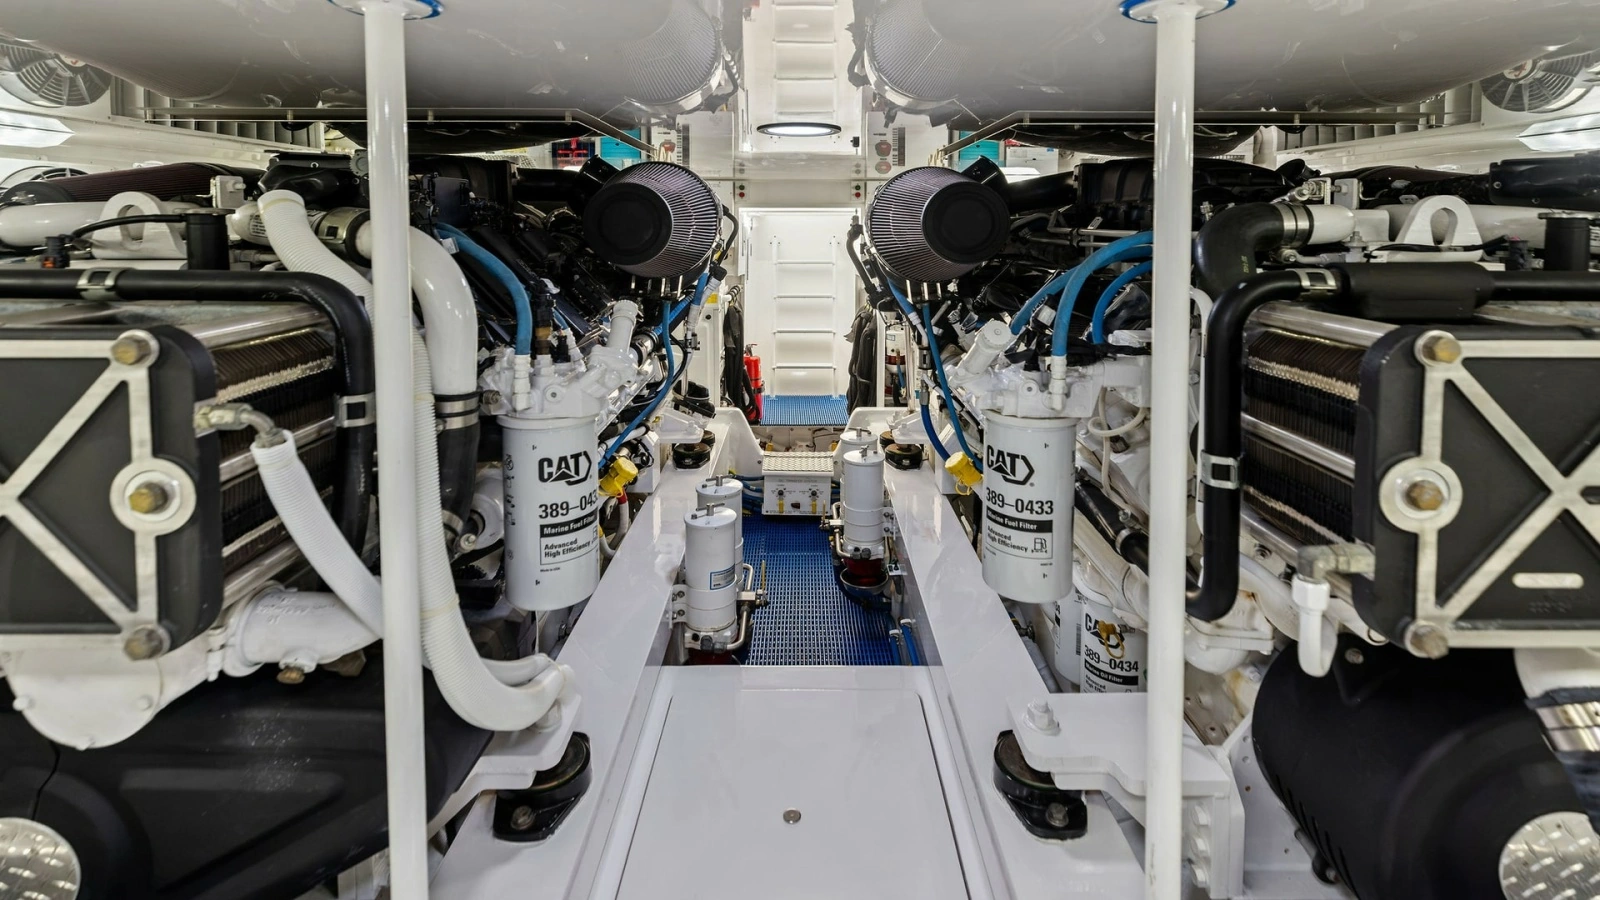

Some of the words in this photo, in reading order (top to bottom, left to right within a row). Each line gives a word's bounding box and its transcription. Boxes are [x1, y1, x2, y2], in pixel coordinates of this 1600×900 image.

[538, 452, 583, 483] CAT
[986, 444, 1021, 478] CAT
[538, 490, 598, 519] 389-043
[986, 487, 1054, 515] 389-0433
[543, 526, 569, 535] Marine
[570, 521, 582, 530] Fuel
[987, 511, 1004, 523] Marine
[1004, 517, 1019, 528] Fuel
[1019, 522, 1037, 530] Filter
[987, 525, 1012, 541] Advanced
[987, 532, 997, 543] High
[998, 539, 1028, 553] Efficiency
[544, 538, 578, 550] Advanced
[544, 550, 561, 558] High
[562, 540, 590, 555] Efficiency
[1084, 645, 1139, 672] 389-0434
[1100, 670, 1108, 679] Oil
[1108, 674, 1123, 683] Filter
